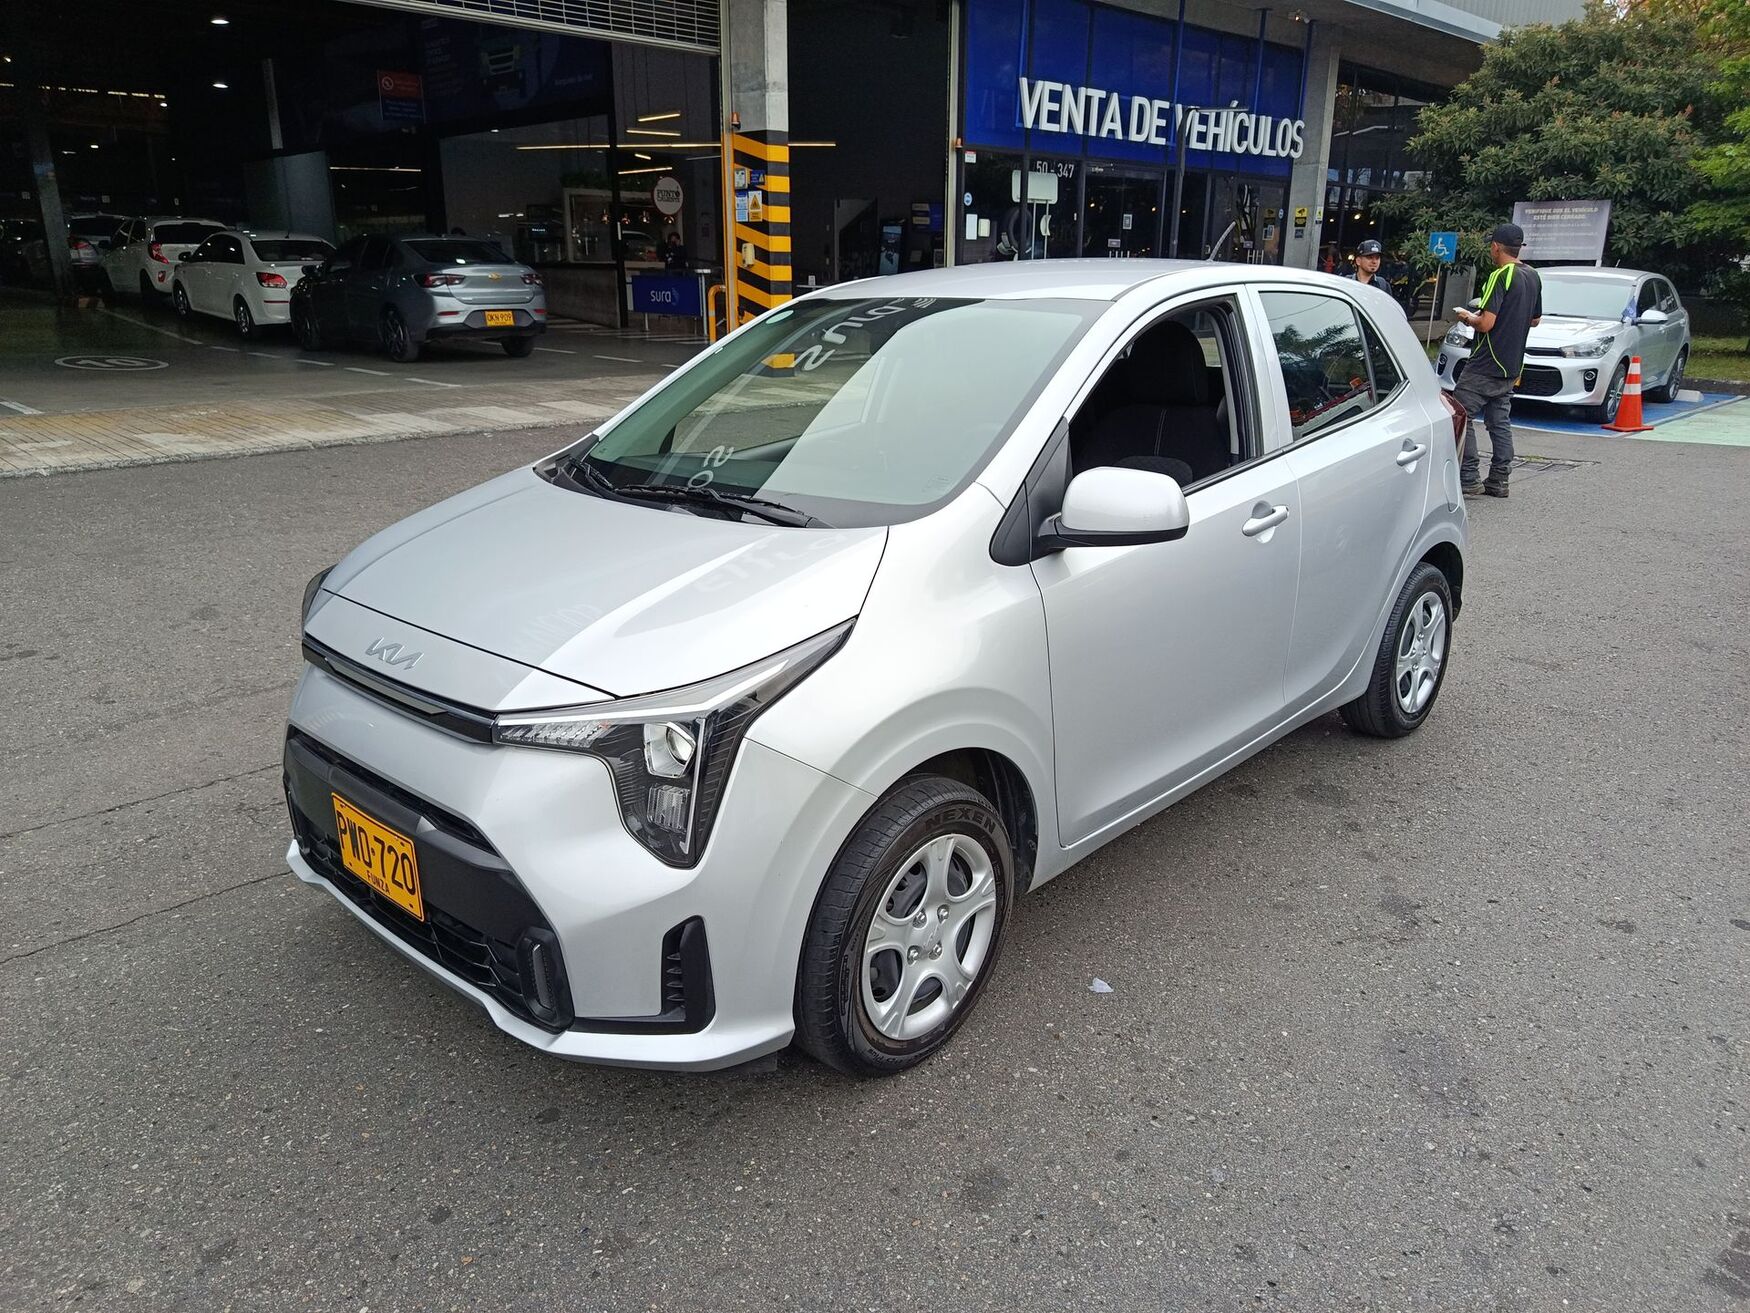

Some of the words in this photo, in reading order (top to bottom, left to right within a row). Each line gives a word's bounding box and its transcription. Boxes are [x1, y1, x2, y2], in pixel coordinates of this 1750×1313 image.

[1019, 77, 1124, 140] VENTA
[1128, 96, 1170, 145] DE
[1057, 162, 1075, 178] 347
[650, 289, 672, 303] sura
[925, 806, 997, 834] NEXEN
[366, 869, 391, 895] FUNZA
